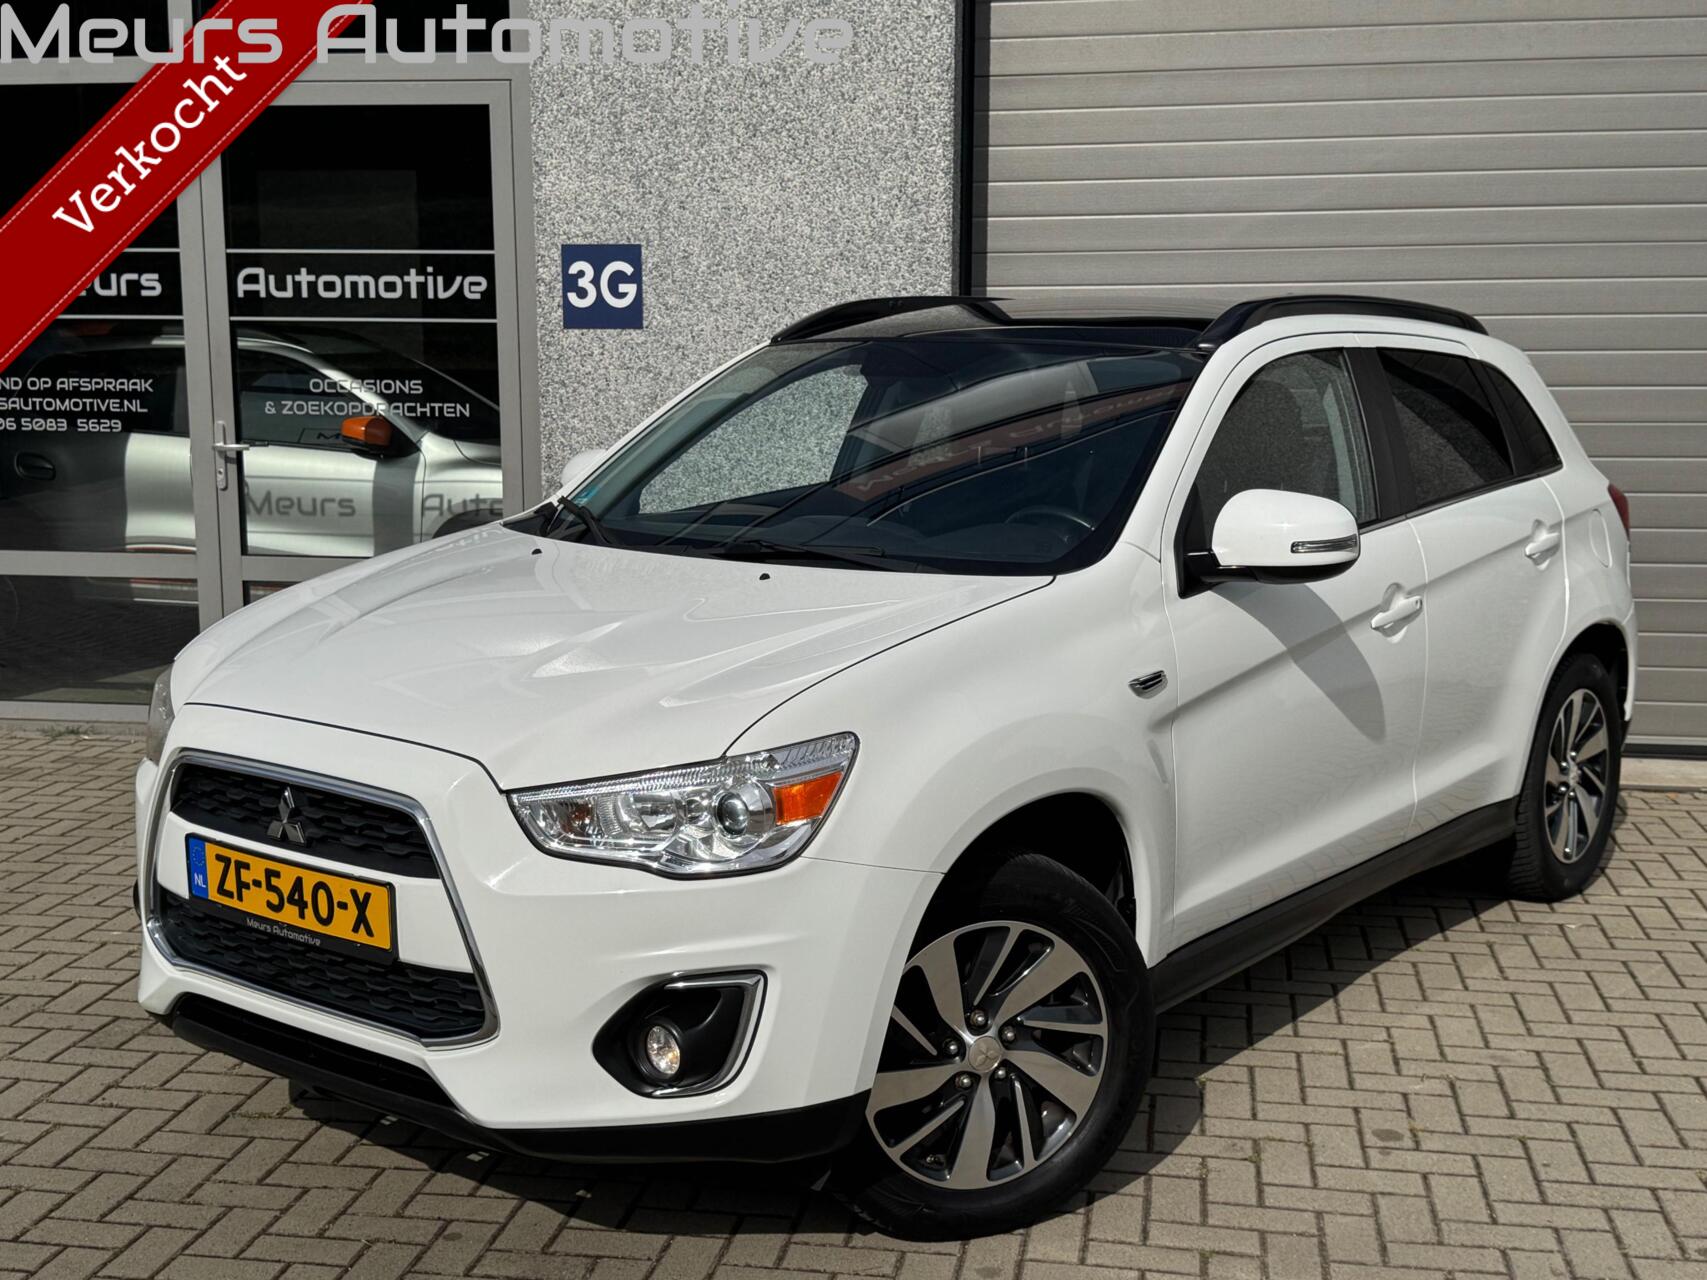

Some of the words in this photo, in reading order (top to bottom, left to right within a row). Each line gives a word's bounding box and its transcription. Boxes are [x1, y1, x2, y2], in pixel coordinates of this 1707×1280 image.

[79, 272, 162, 297] urs
[236, 267, 488, 300] Automotive
[566, 261, 638, 308] 3G
[27, 377, 52, 391] OP
[56, 378, 153, 392] AFSPRAAK
[309, 378, 423, 395] OCCASIONS
[265, 402, 276, 414] &
[281, 401, 471, 418] ZOEKOPDRACHTEN
[21, 418, 67, 431] 5083
[77, 419, 122, 432] 5629
[246, 490, 356, 517] Meurs
[194, 872, 206, 888] NL
[214, 853, 375, 938] ZF-540-X
[246, 917, 272, 932] Meurs
[272, 925, 322, 946] Automotive
